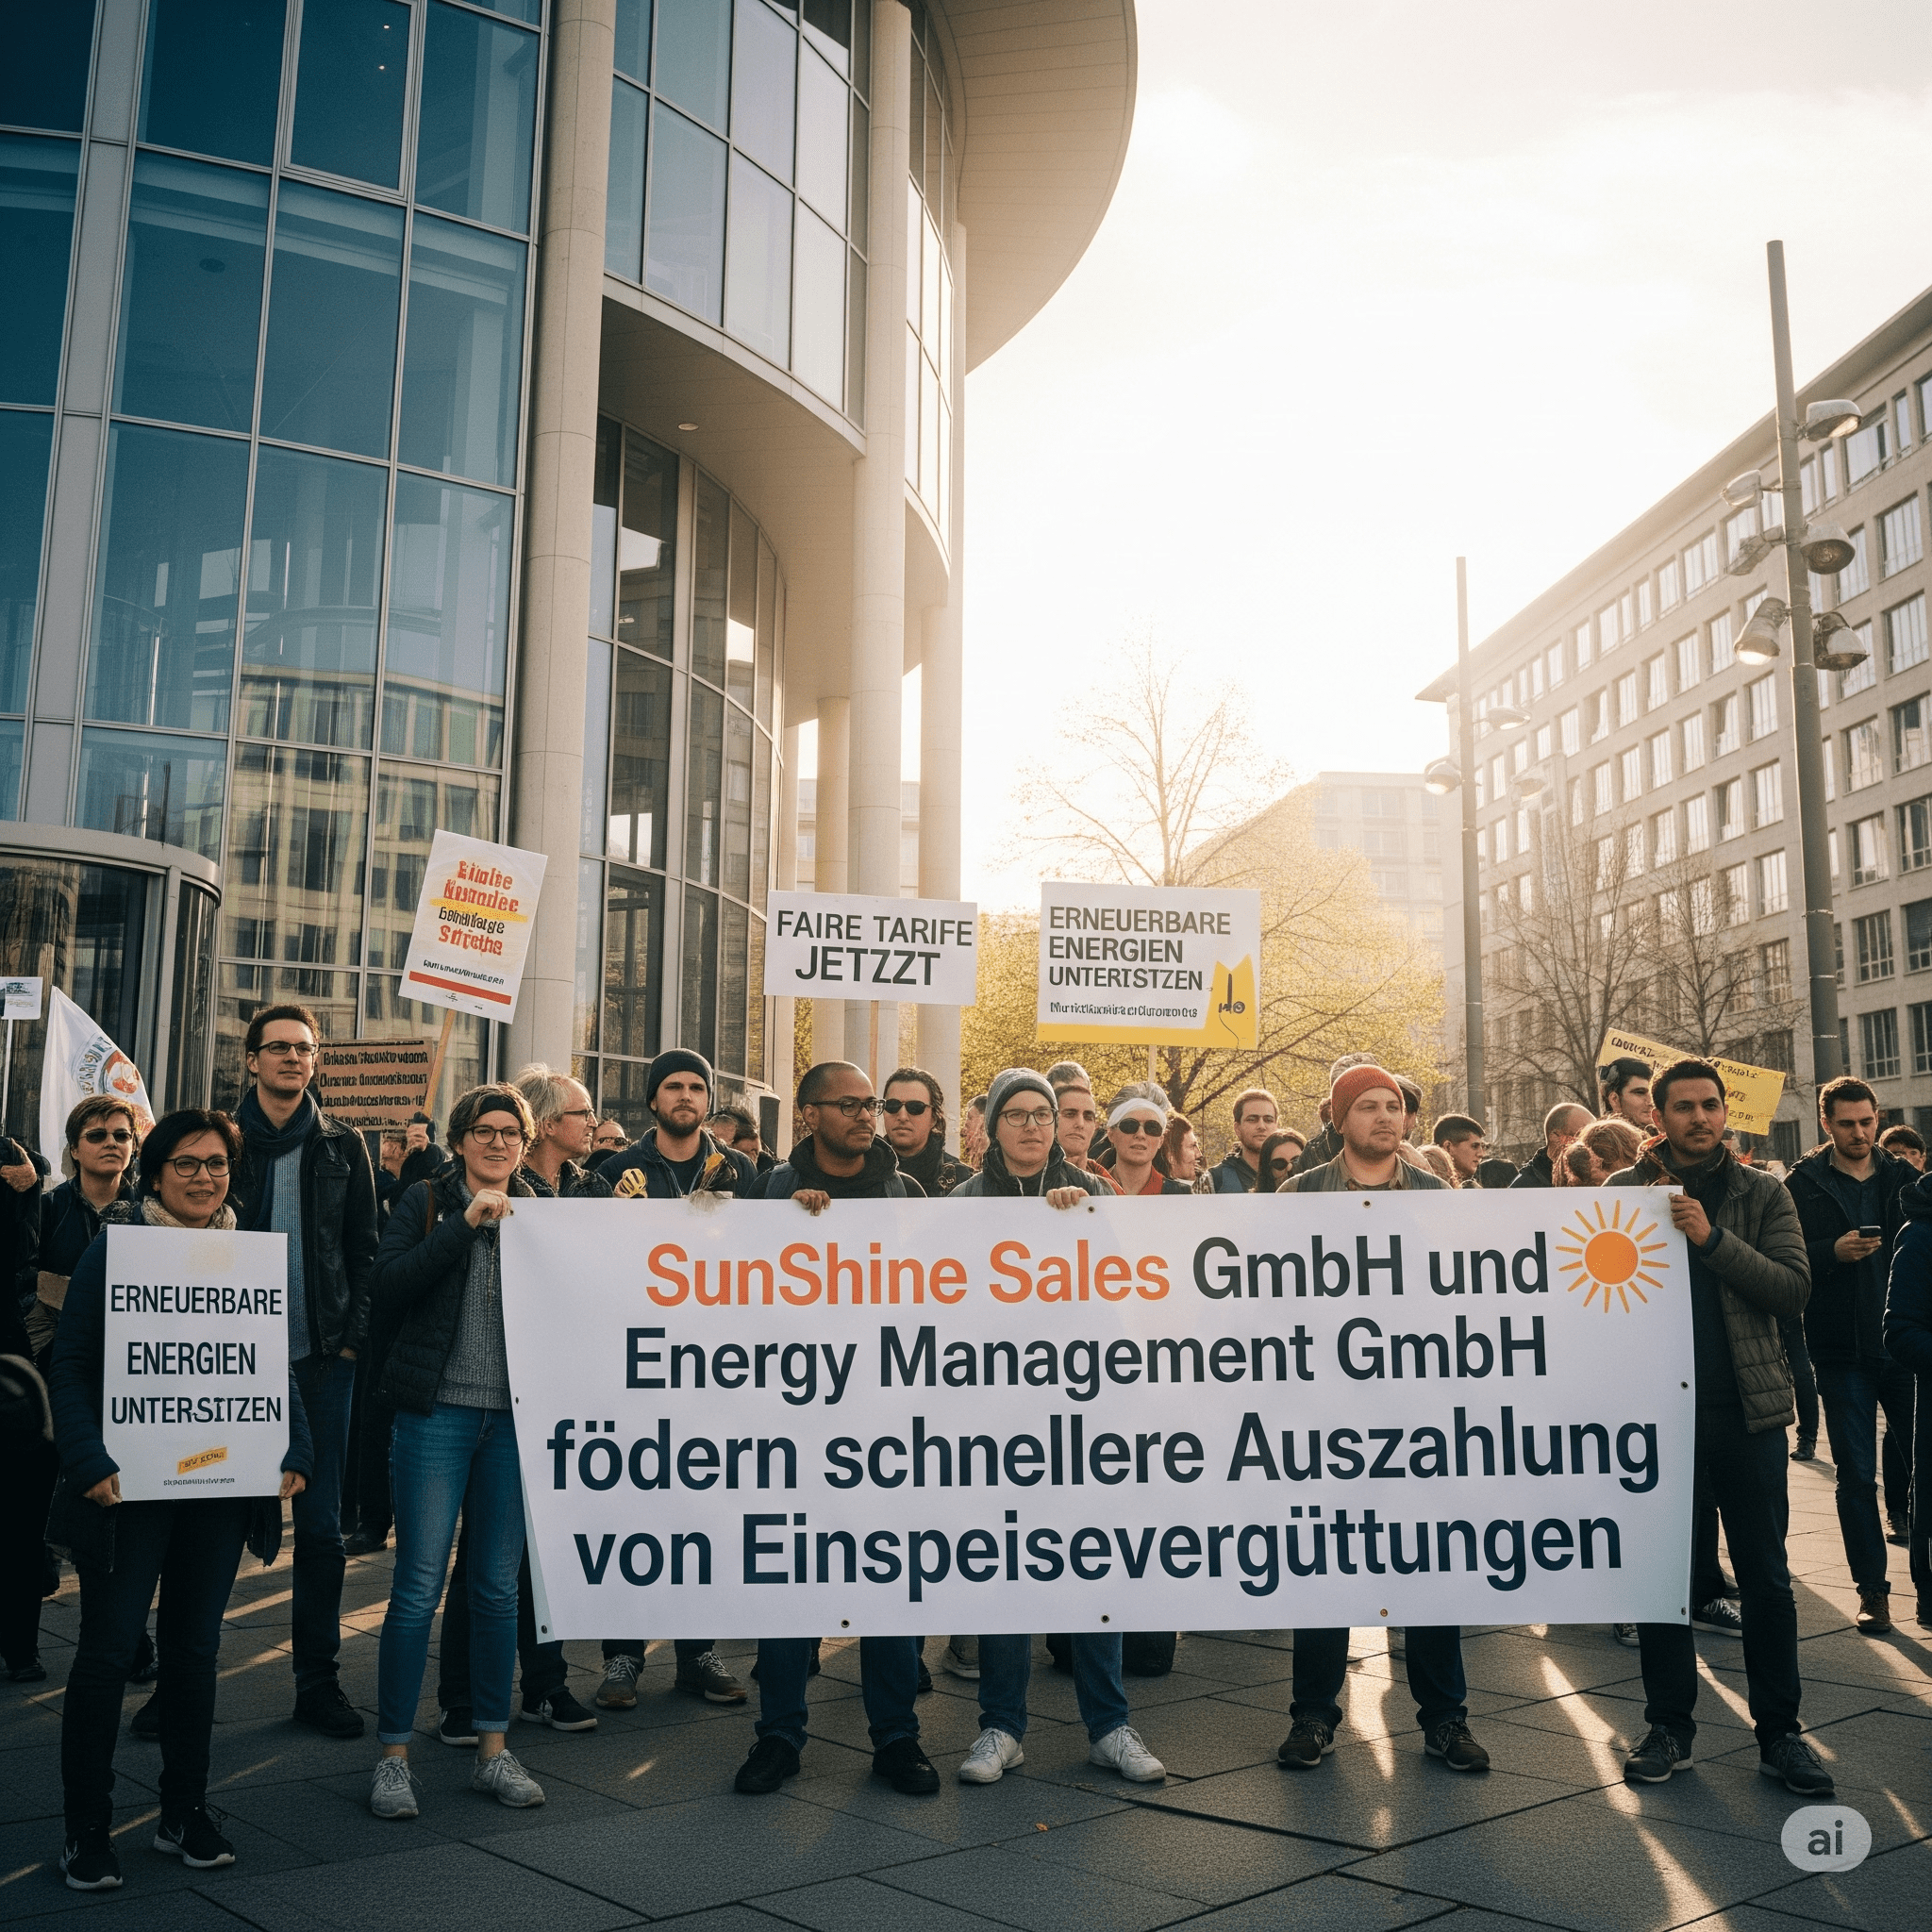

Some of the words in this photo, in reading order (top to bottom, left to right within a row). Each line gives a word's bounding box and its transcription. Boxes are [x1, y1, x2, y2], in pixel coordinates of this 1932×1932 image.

[777, 909, 862, 941] FAIRE
[873, 915, 973, 946] TARIFE
[1049, 906, 1231, 936] ERNEUERBARE
[794, 945, 941, 986] JETZZT
[1049, 936, 1183, 964] ENERGIEN
[646, 1241, 968, 1307] SunShine
[989, 1239, 1171, 1304] Sales
[1192, 1234, 1404, 1300] GmbH
[1428, 1231, 1549, 1296] und
[110, 1284, 283, 1316] ERNEUERBARE
[127, 1341, 256, 1375] ENERGIEN
[625, 1326, 858, 1407] Energy
[880, 1324, 1315, 1404] Management
[1337, 1314, 1547, 1381] GmbH
[546, 1418, 797, 1491] födern
[824, 1413, 1205, 1490] schnellere
[1226, 1405, 1660, 1494] Auszahlung
[573, 1531, 712, 1587] von
[742, 1507, 1623, 1603] Einspeisevergüttungen
